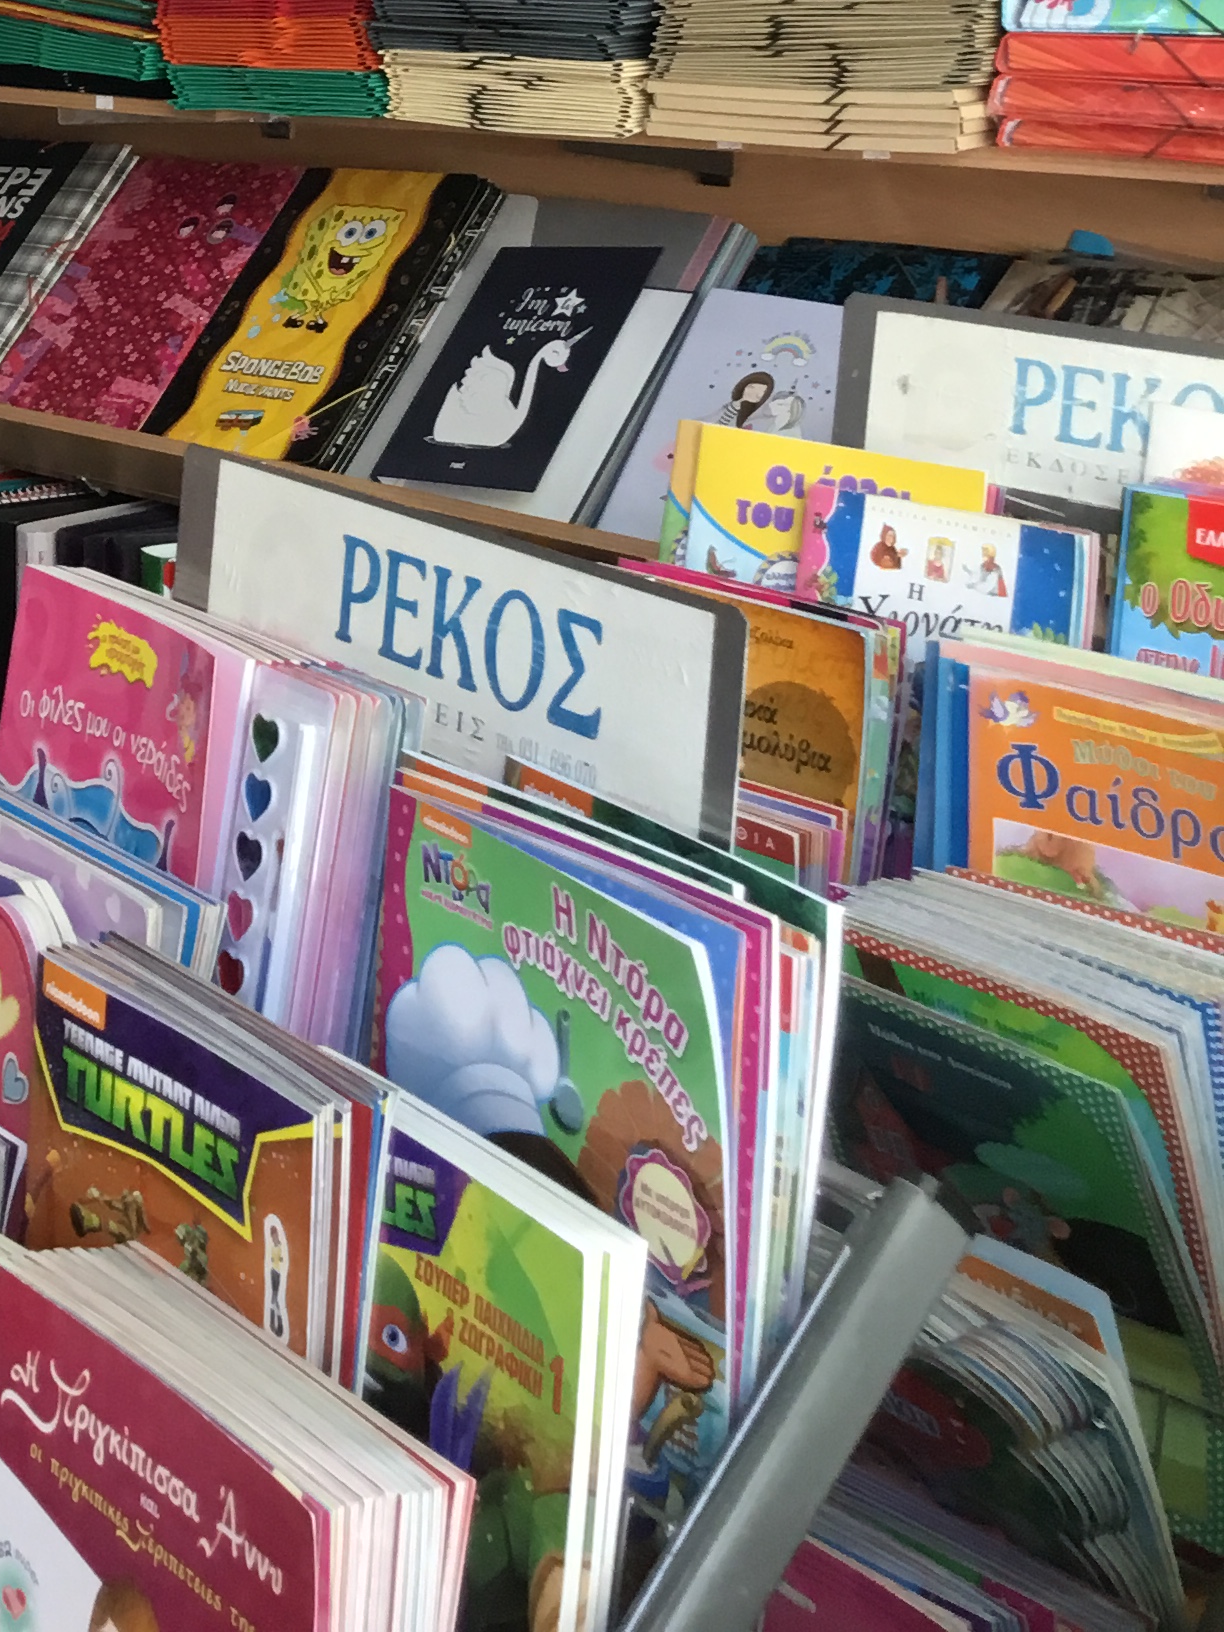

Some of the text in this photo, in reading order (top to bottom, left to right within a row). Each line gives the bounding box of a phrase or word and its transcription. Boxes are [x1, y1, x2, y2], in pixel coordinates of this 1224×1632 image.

[502, 315, 573, 338] unicorn
[219, 351, 326, 385] SPONGEBOB
[765, 464, 805, 500] Οι
[1005, 447, 1132, 486] ΕΚΔΟΣΕ
[1195, 527, 1224, 549] ΕΛΛ
[907, 582, 925, 602] Η
[1169, 577, 1224, 633] Οδυ
[334, 533, 606, 741] ΡΕΚΟΣ
[19, 689, 35, 718] Οι
[38, 684, 85, 733] φίλες
[85, 711, 111, 744] μου
[112, 725, 127, 750] οι
[433, 701, 486, 742] ΕΙΣ
[1070, 738, 1218, 802] Μύθοι του
[422, 815, 470, 844] nickelodeon
[45, 979, 101, 1024] nickelodeon
[550, 882, 690, 1058] Η Ντόρα
[501, 921, 612, 1023] φτιάχνει
[613, 1003, 710, 1153] κρέπες
[62, 1017, 242, 1142] TEENAGE MUTANT NINJA
[62, 1044, 240, 1202] TURTLES
[380, 1177, 437, 1243] LES
[414, 1253, 546, 1365] ΣΟΥΠΕΡ ΠΑΙΧΝΙΔΙΑ
[458, 1316, 544, 1400] ΖΩΓΡΑΦΙΚΗ
[548, 1354, 565, 1416] 1
[0, 1358, 202, 1524] Πριγκίπισσα
[29, 1442, 43, 1464] οι
[49, 1457, 130, 1533] πριγκιπικές
